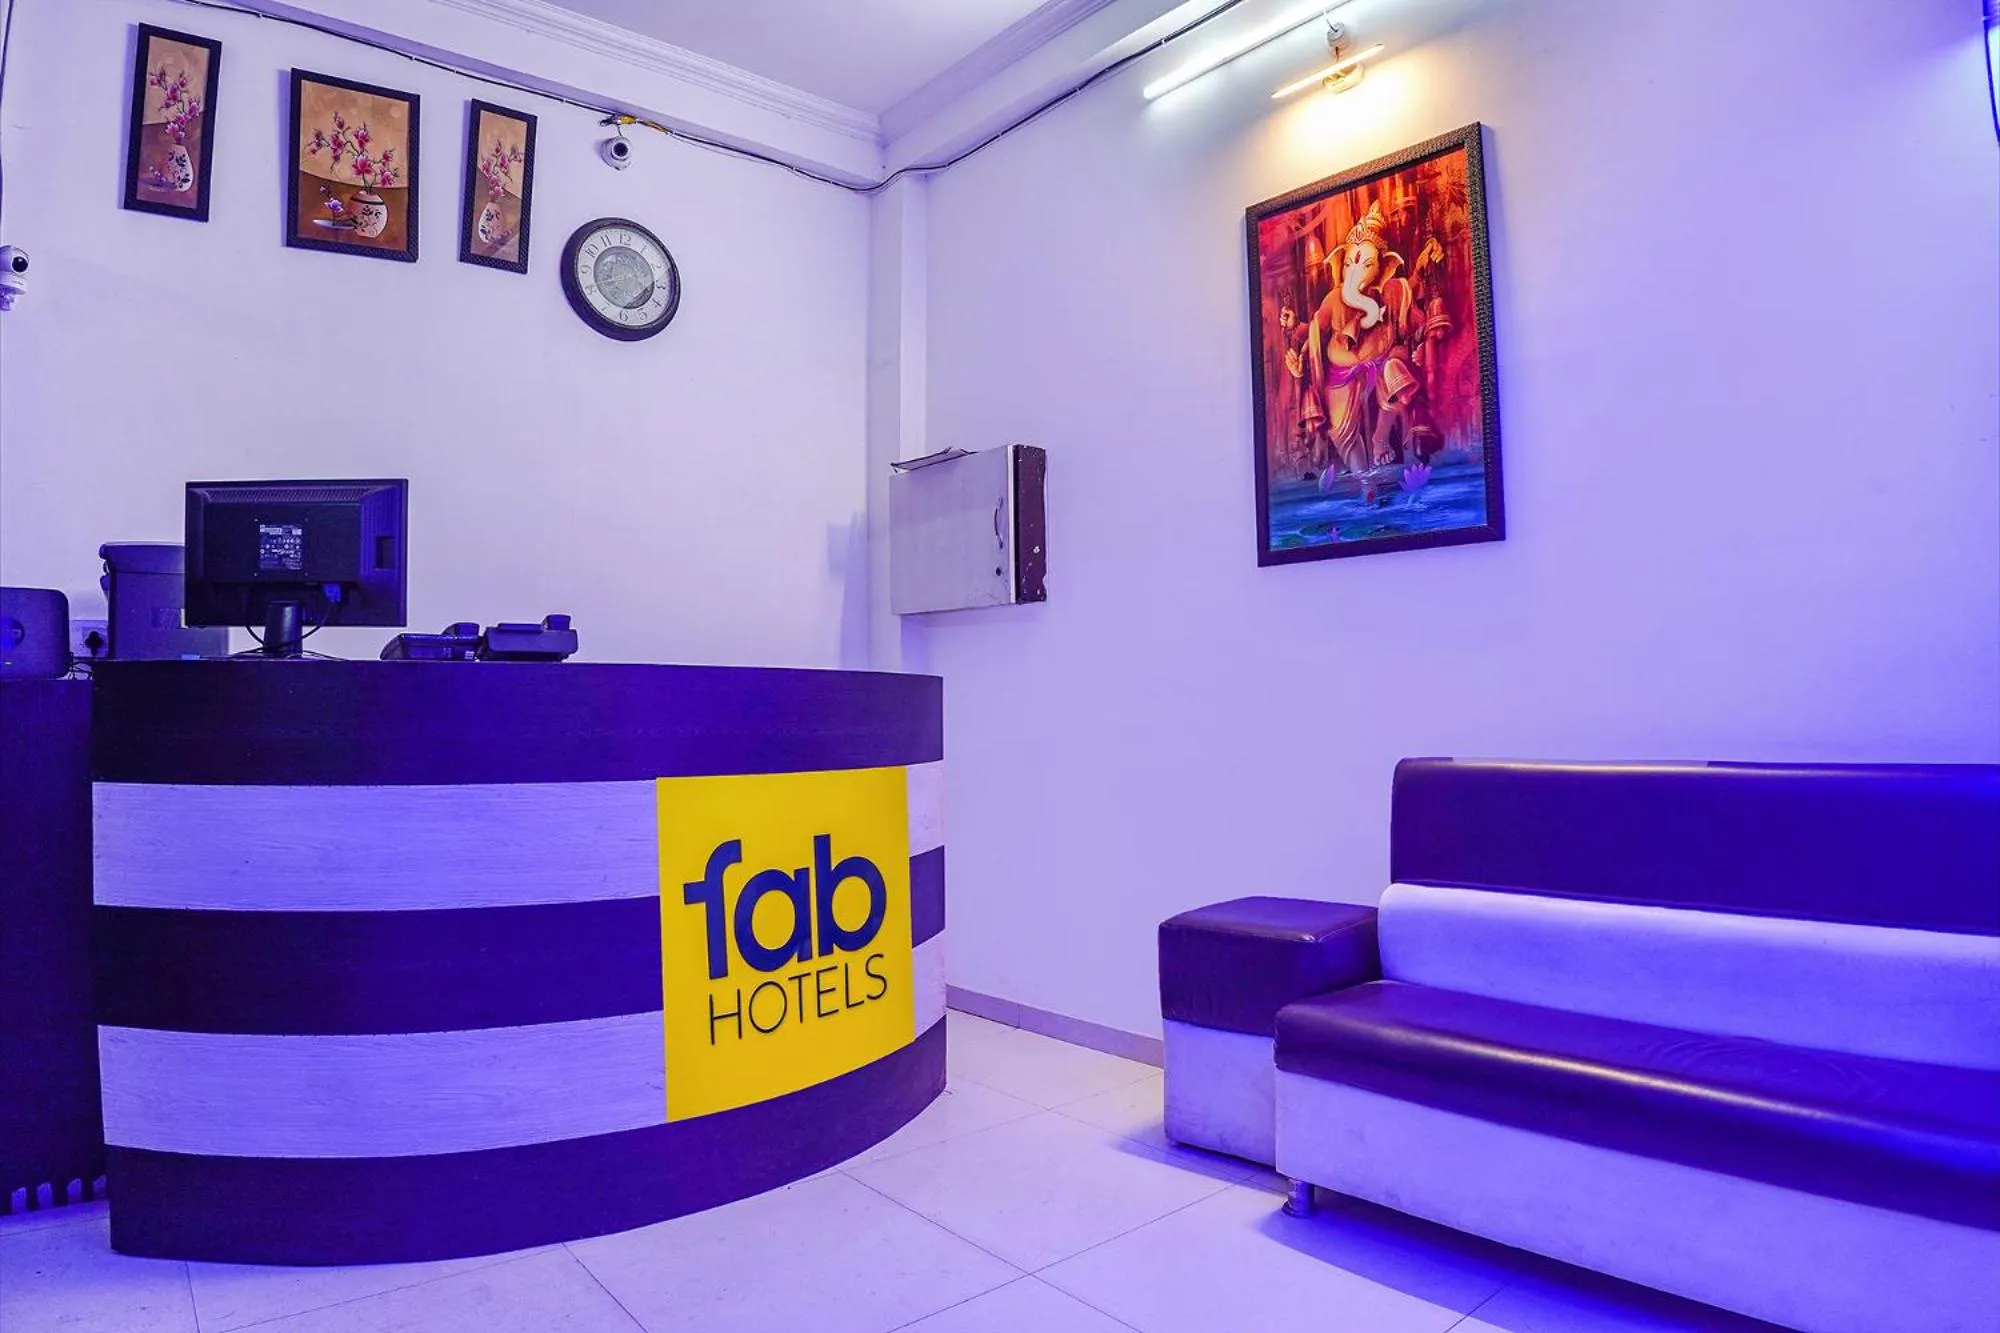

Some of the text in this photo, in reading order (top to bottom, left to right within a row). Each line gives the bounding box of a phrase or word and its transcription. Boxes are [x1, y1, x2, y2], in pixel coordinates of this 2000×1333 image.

[620, 233, 632, 246] 12
[683, 834, 887, 980] fab
[708, 953, 888, 1046] HOTELS
